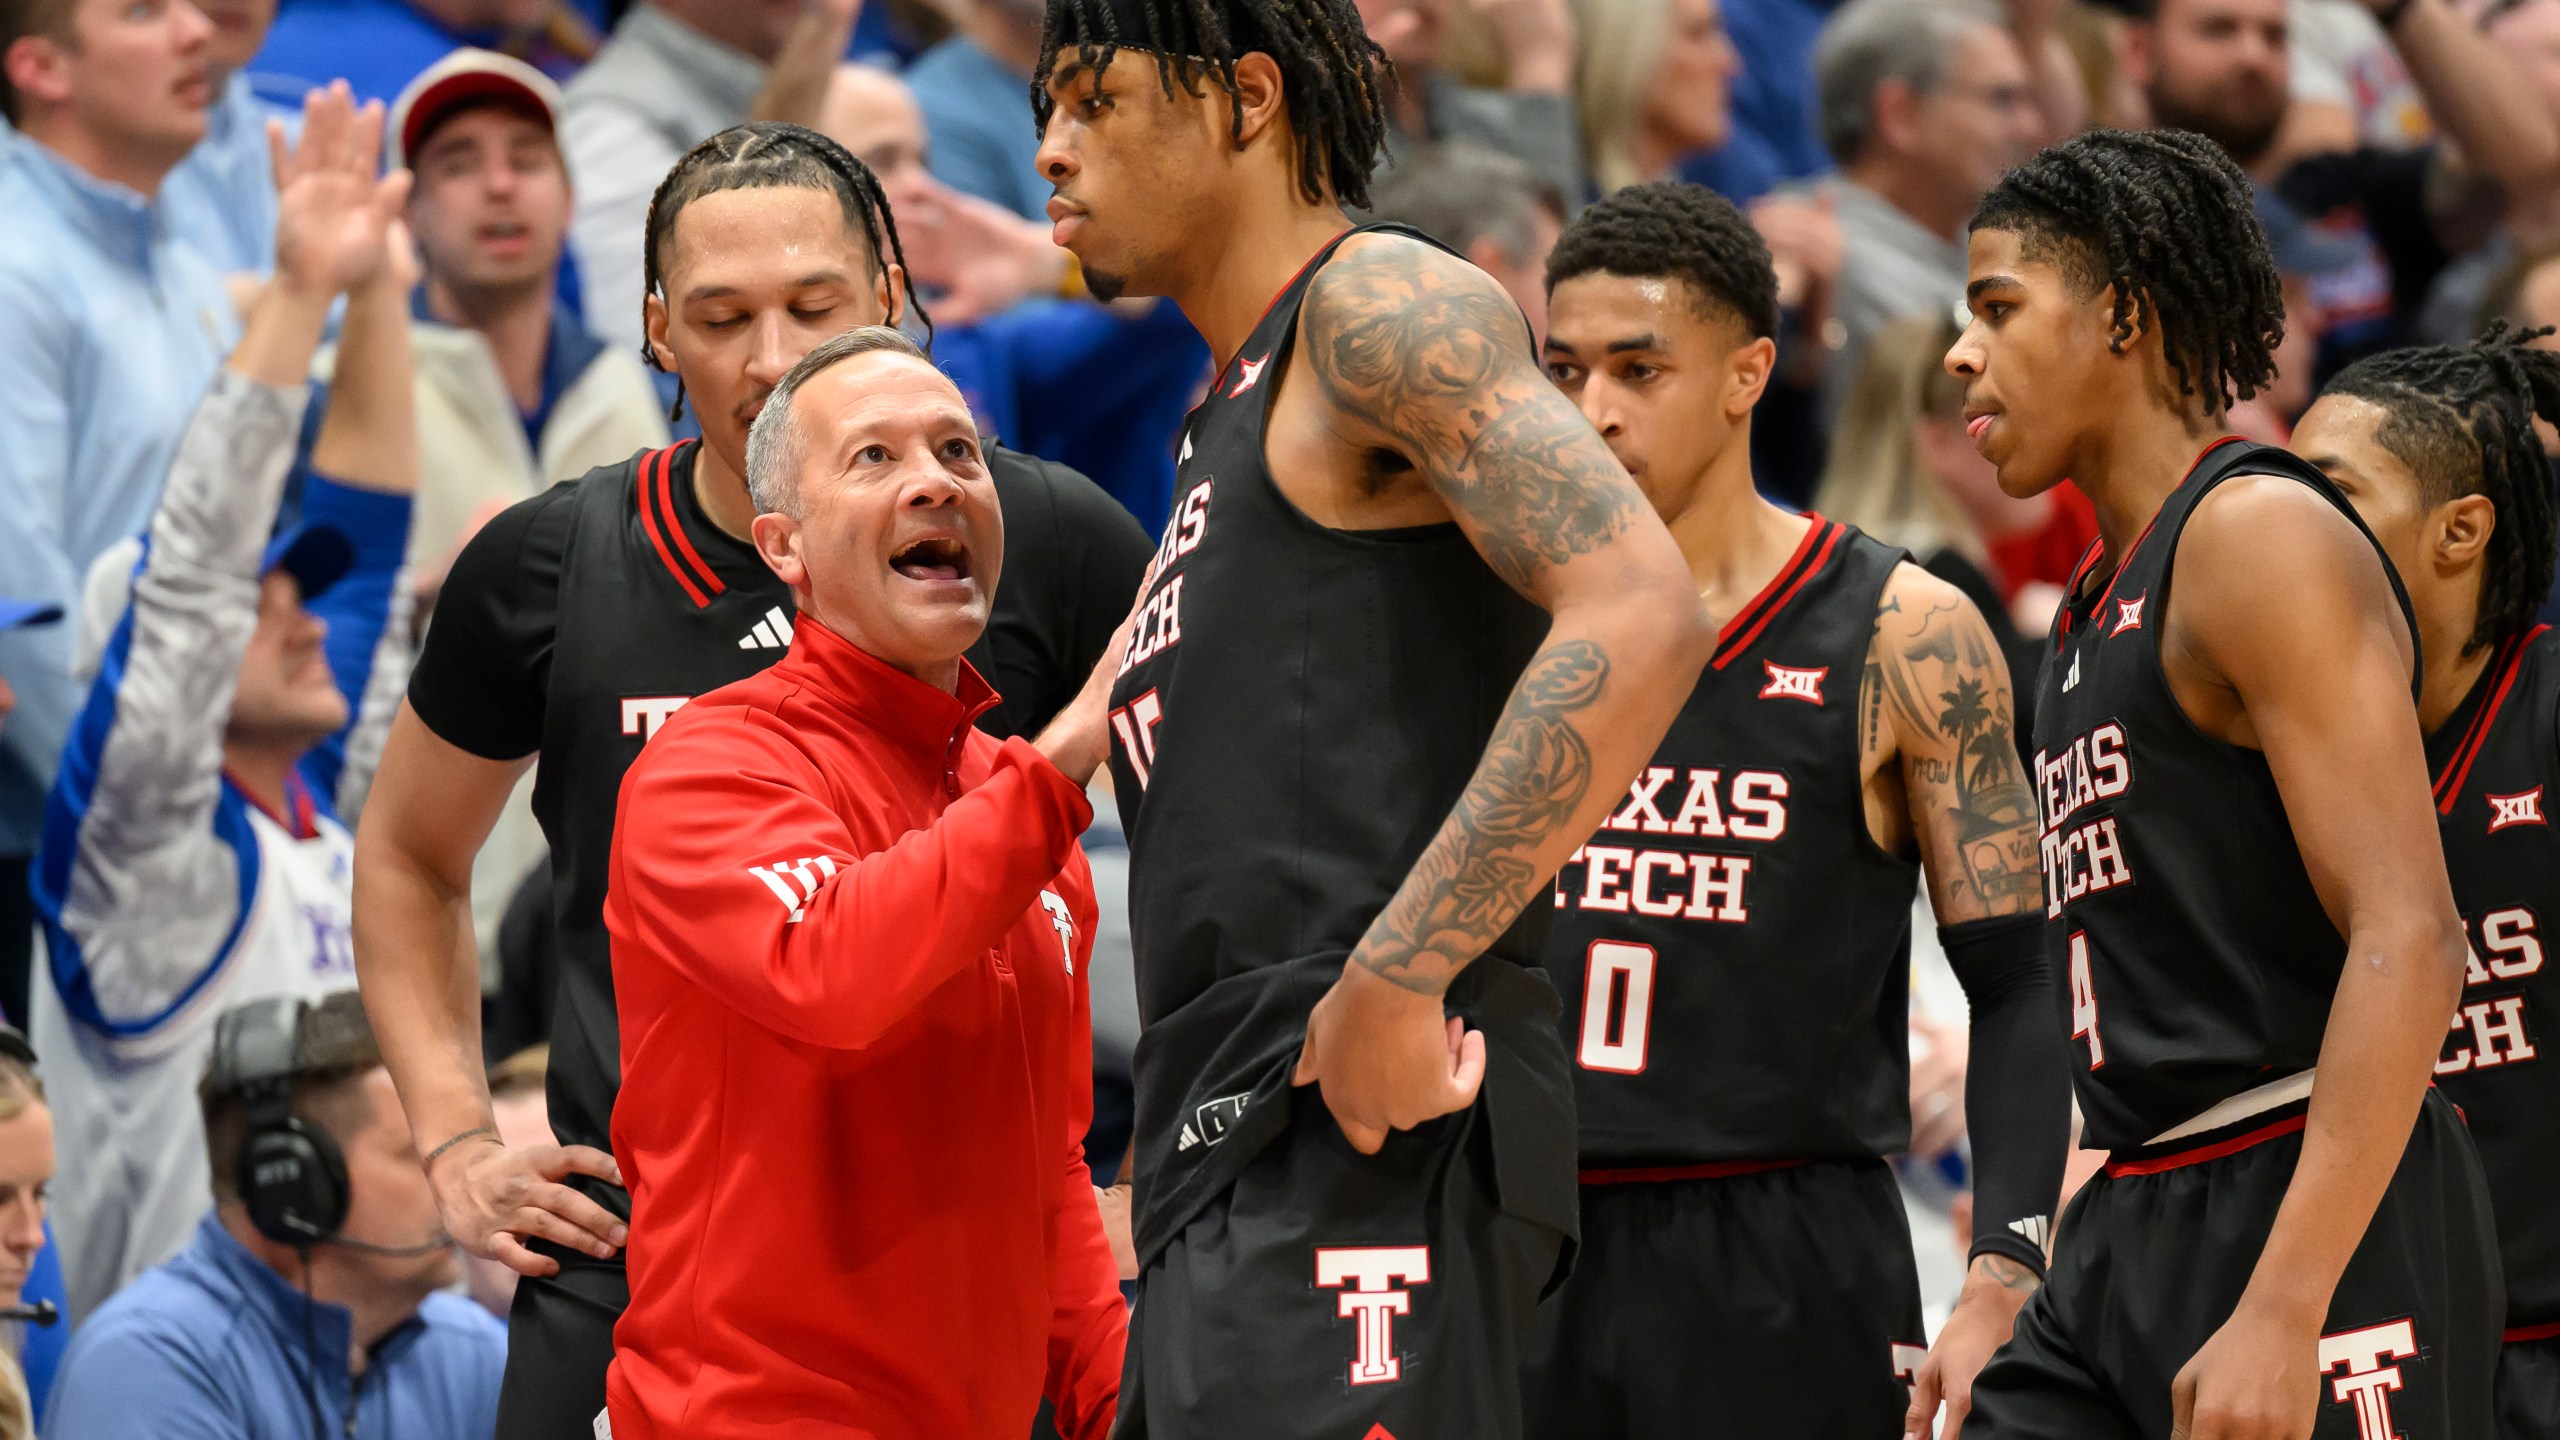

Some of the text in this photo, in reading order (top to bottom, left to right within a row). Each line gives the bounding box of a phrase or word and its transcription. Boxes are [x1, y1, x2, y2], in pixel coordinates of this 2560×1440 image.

[1117, 572, 1184, 680] ECH
[1763, 664, 1824, 701] XII
[1600, 766, 1788, 840] XAS
[2035, 724, 2132, 840] TEXAS
[2489, 790, 2543, 828] XII
[1577, 938, 1658, 1075] 0
[2069, 929, 2105, 1070] 4
